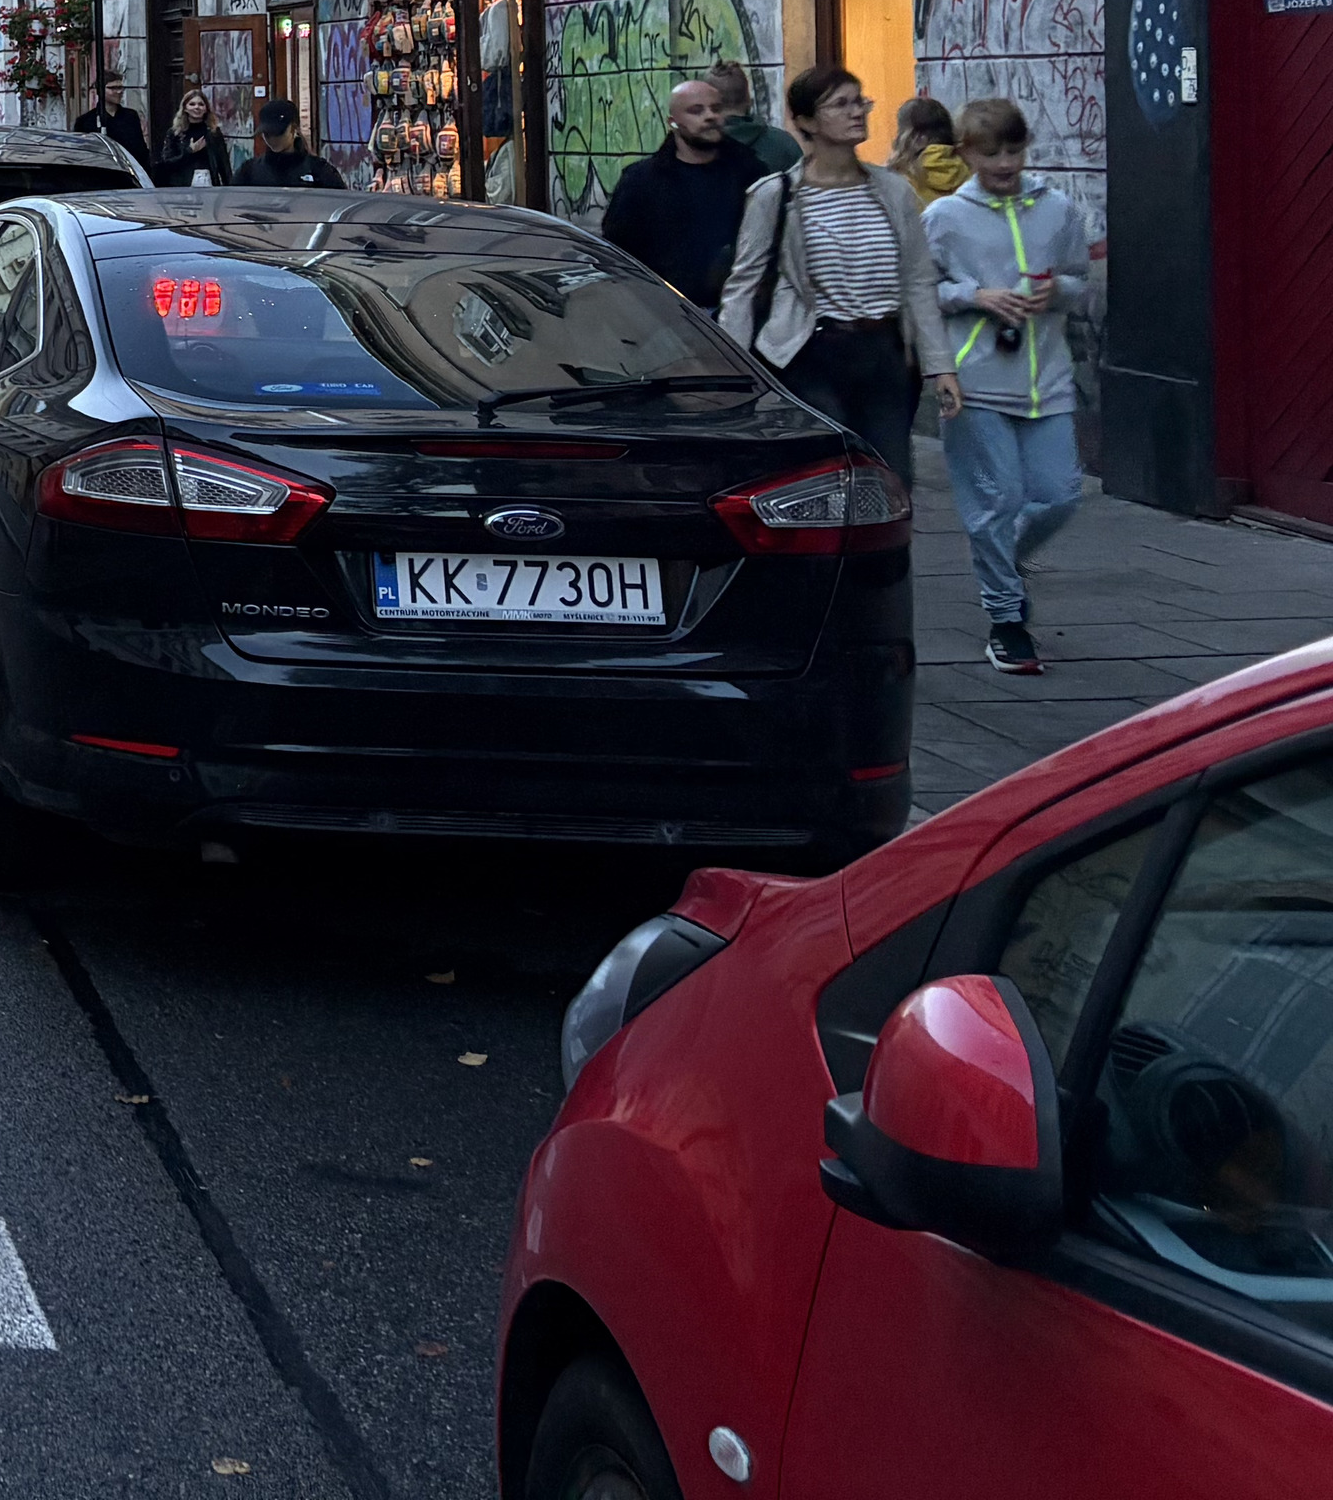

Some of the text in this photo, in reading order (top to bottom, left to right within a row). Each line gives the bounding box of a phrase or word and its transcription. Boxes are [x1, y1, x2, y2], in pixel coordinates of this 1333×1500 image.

[502, 516, 547, 536] Ford
[378, 557, 651, 610] PL KK 7730H
[221, 601, 331, 619] MONDEO
[379, 609, 419, 617] CENTRUM
[421, 609, 490, 618] MOTORYZACYJNE
[563, 612, 605, 621] MYŚLENICE
